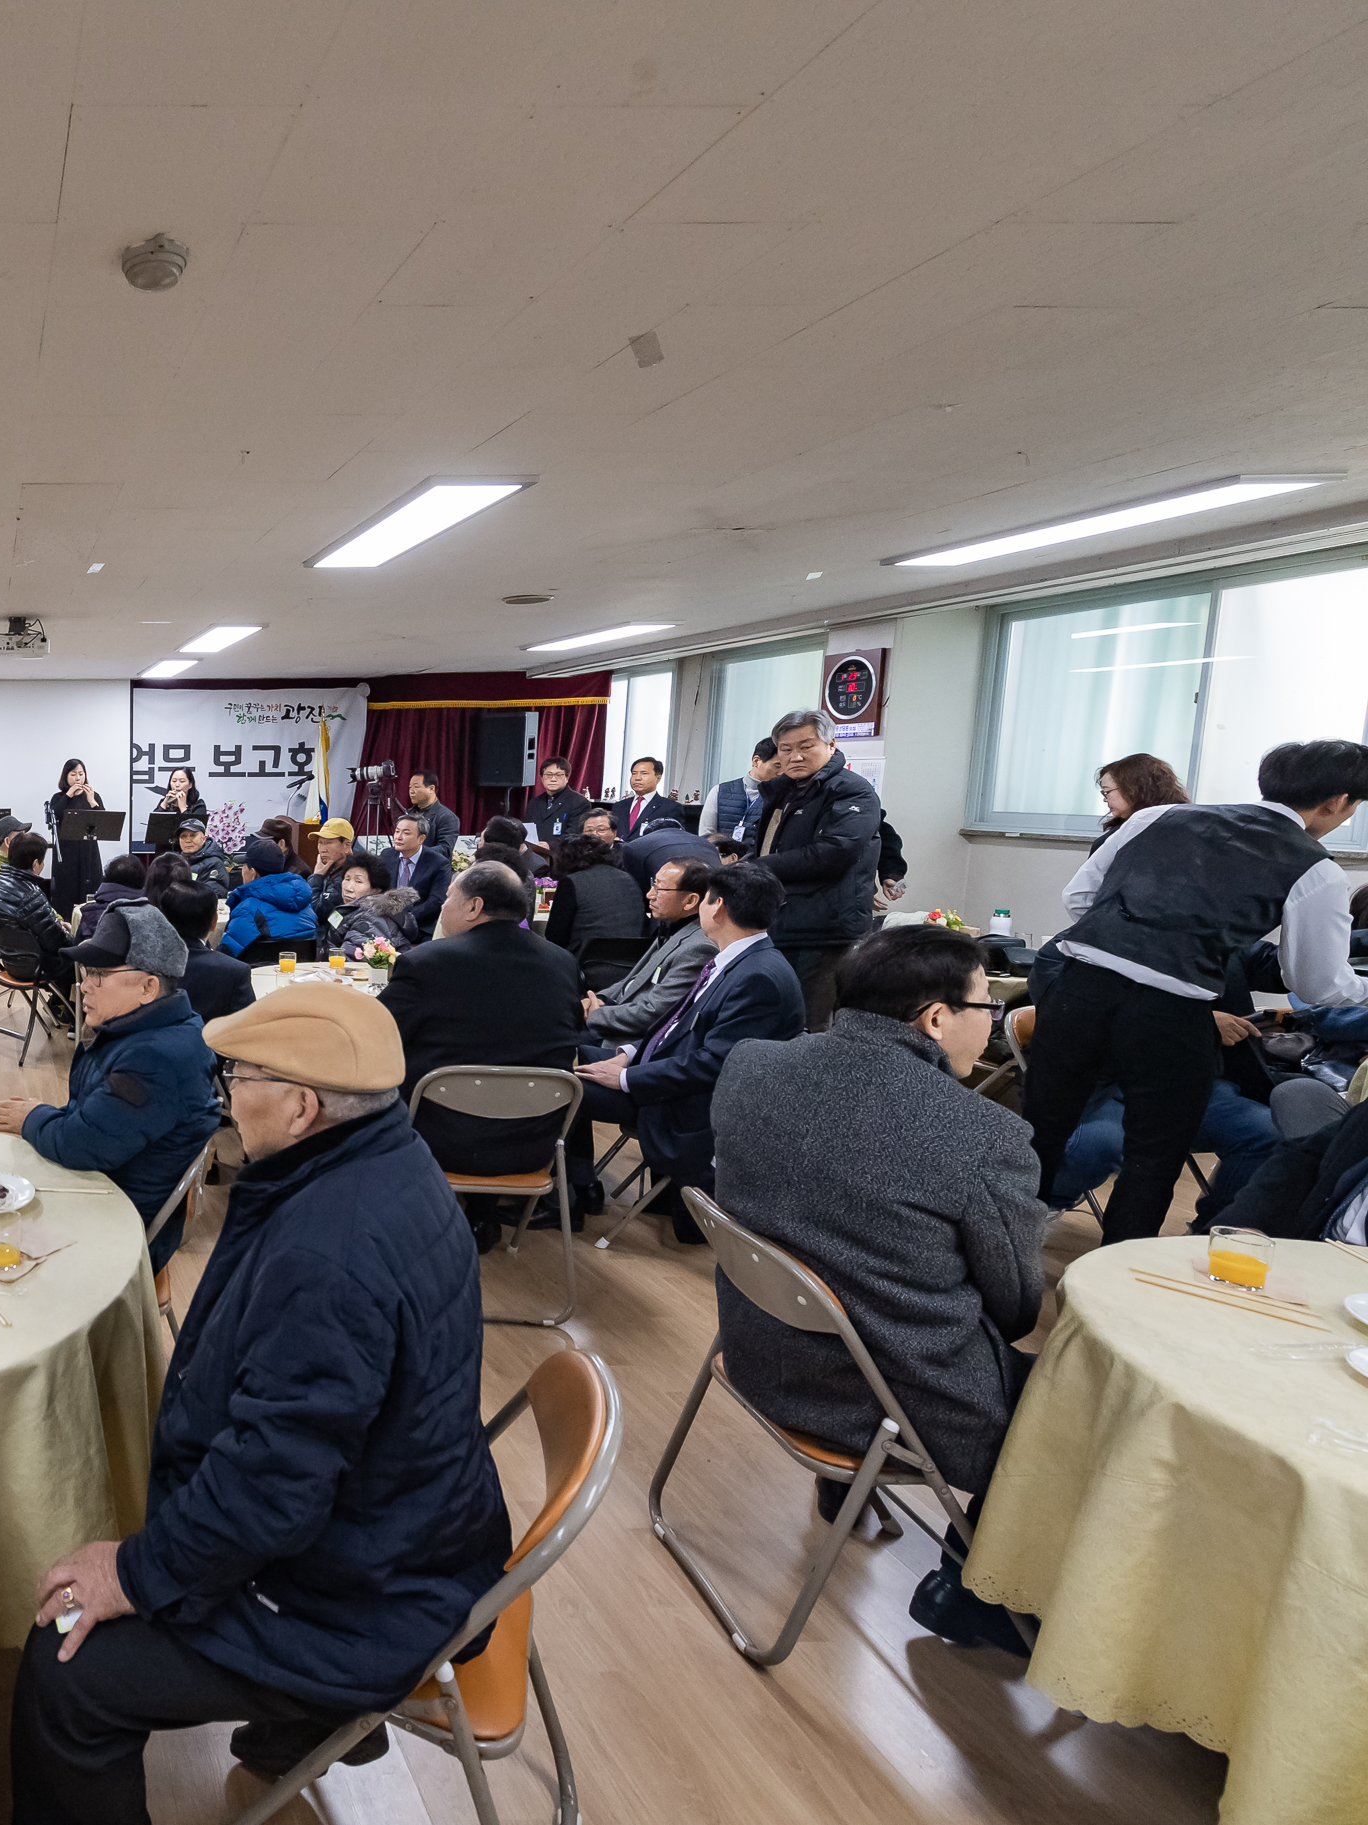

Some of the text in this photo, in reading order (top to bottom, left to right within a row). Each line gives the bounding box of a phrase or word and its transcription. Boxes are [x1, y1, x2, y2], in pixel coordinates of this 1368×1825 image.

[224, 702, 244, 716] 구민이
[266, 703, 282, 712] 가치
[236, 713, 278, 724] 함께 만드는
